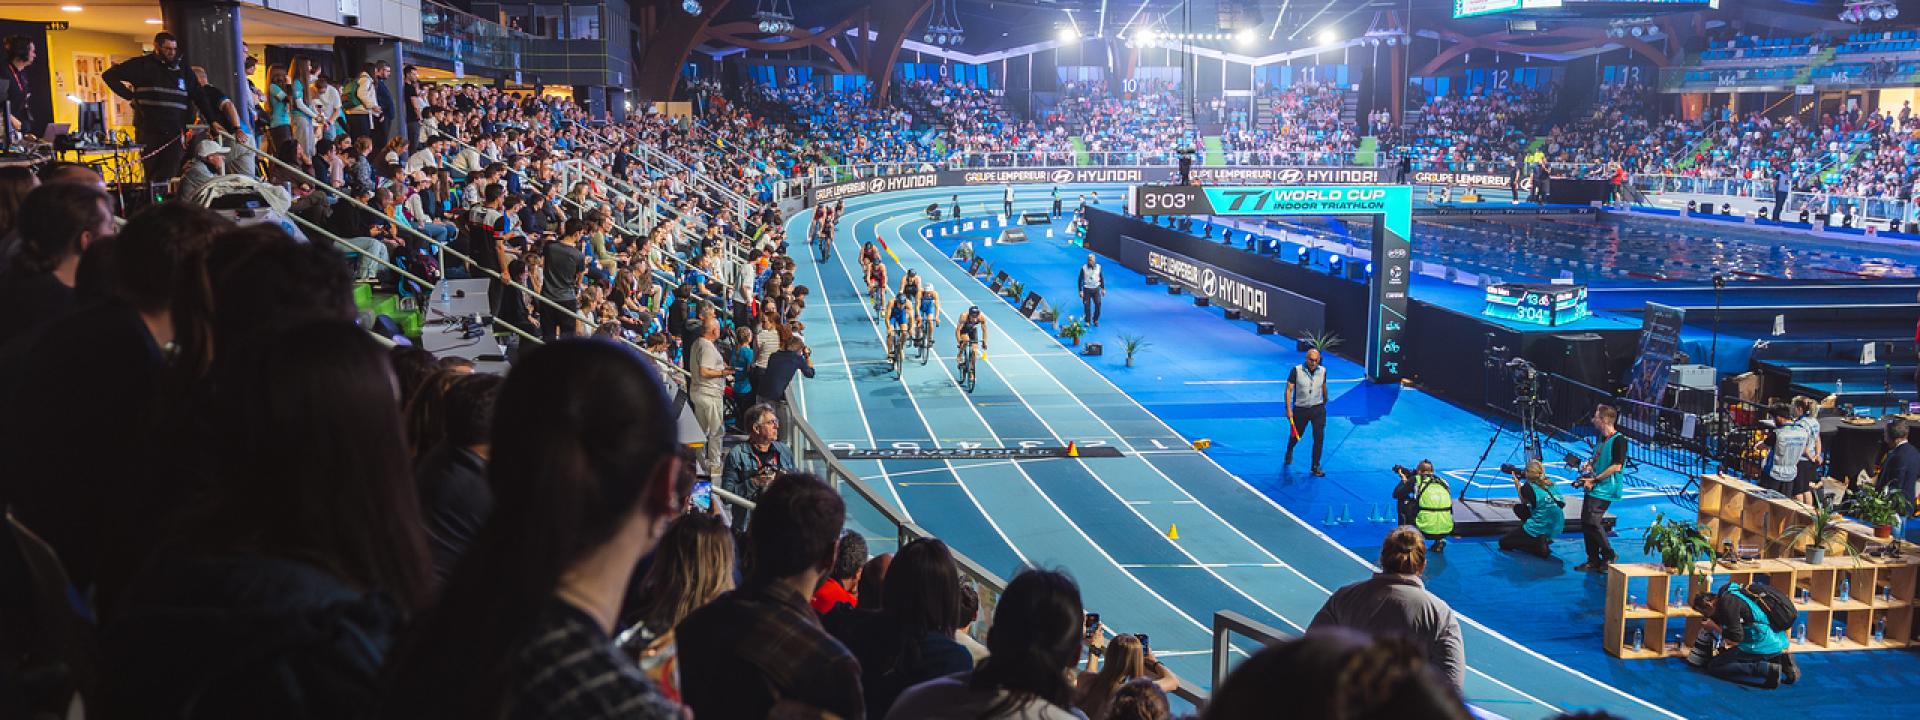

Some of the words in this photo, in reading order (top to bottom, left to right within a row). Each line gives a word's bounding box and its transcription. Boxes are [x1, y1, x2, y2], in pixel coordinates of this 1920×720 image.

[1301, 67, 1316, 81] 11
[1491, 70, 1509, 89] 12
[1621, 66, 1640, 86] 13
[1831, 72, 1848, 83] M5
[1122, 79, 1137, 92] 10
[1718, 75, 1735, 86] M4
[964, 172, 997, 181] GROUPE
[997, 170, 1046, 181] LEMPEREUR
[1076, 170, 1141, 181] HYUNDAI
[1214, 170, 1271, 180] LEMPEREUR
[1415, 172, 1453, 182] GROUPE
[887, 174, 937, 189] HYUNDAI
[1145, 194, 1195, 208] 3'03"
[1274, 190, 1341, 200] WORLD
[1347, 190, 1386, 200] CUP
[1273, 202, 1318, 210] INDOOR
[1218, 275, 1267, 317] HYUNDAI
